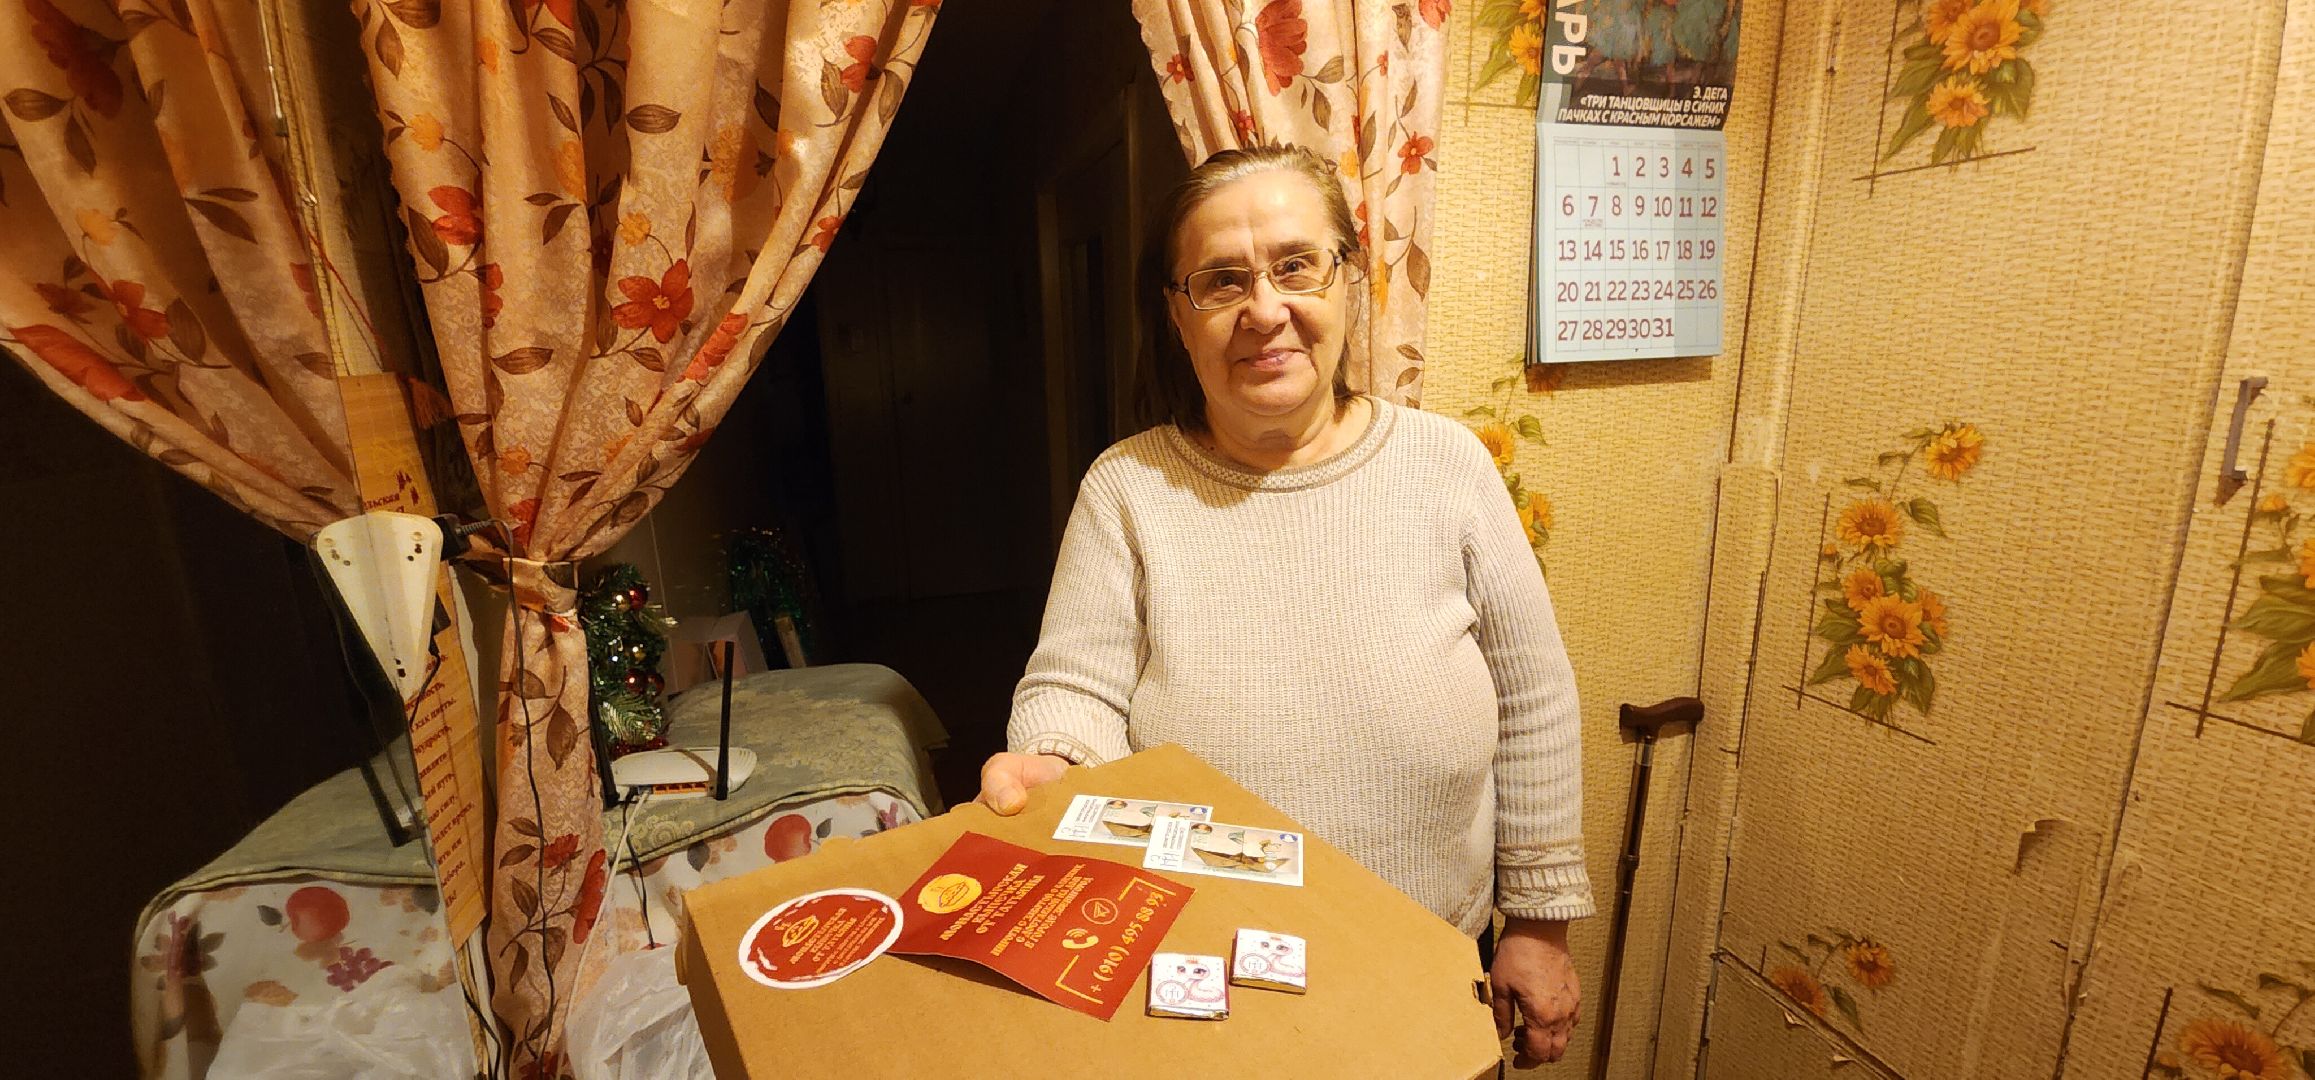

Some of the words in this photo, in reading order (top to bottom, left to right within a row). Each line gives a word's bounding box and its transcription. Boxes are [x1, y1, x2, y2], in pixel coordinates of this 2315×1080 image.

[1580, 94, 1607, 108] «ТРИ
[1608, 96, 1683, 113] ТАНЦОВЩИЦЫ
[1683, 101, 1690, 111] В
[1691, 101, 1726, 114] СИНИХ
[1702, 87, 1728, 101] ДЕГА
[1557, 108, 1602, 122] ПАЧКАХ
[1602, 111, 1609, 122] С
[1610, 111, 1661, 126] КРАСНЫМ
[1661, 113, 1721, 128] КОРСАЖЕМ»
[1612, 156, 1620, 176] 1
[1635, 156, 1646, 177] 2
[1659, 157, 1669, 178] 3
[1681, 158, 1693, 178] 4
[1705, 158, 1715, 179] 5
[1562, 194, 1574, 216] 6
[1588, 195, 1598, 217] 7
[1612, 195, 1622, 216] 8
[1635, 195, 1645, 216] 9
[1654, 196, 1672, 217] 10
[1679, 197, 1693, 217] 11
[1700, 197, 1717, 217] 12
[1558, 240, 1577, 261] 13
[1584, 240, 1602, 261] 14
[1609, 240, 1625, 260] 15
[1632, 240, 1649, 260] 16
[1656, 240, 1670, 261] 17
[1677, 240, 1692, 260] 18
[1699, 239, 1715, 260] 19
[1557, 281, 1579, 302] 20
[1584, 281, 1602, 302] 21
[1607, 280, 1627, 301] 22
[1631, 280, 1650, 301] 23
[1654, 280, 1674, 300] 24
[1677, 279, 1695, 300] 25
[1698, 279, 1717, 299] 26
[1558, 320, 1579, 341] 27
[1583, 319, 1603, 340] 28
[1605, 319, 1627, 339] 29
[1628, 318, 1650, 339] 30
[1652, 318, 1674, 338] 31
[1144, 891, 1167, 907] 93
[1133, 906, 1156, 922] 88
[974, 919, 995, 934] ОТ
[1117, 920, 1146, 945] 495
[1089, 944, 1132, 982] (910)
